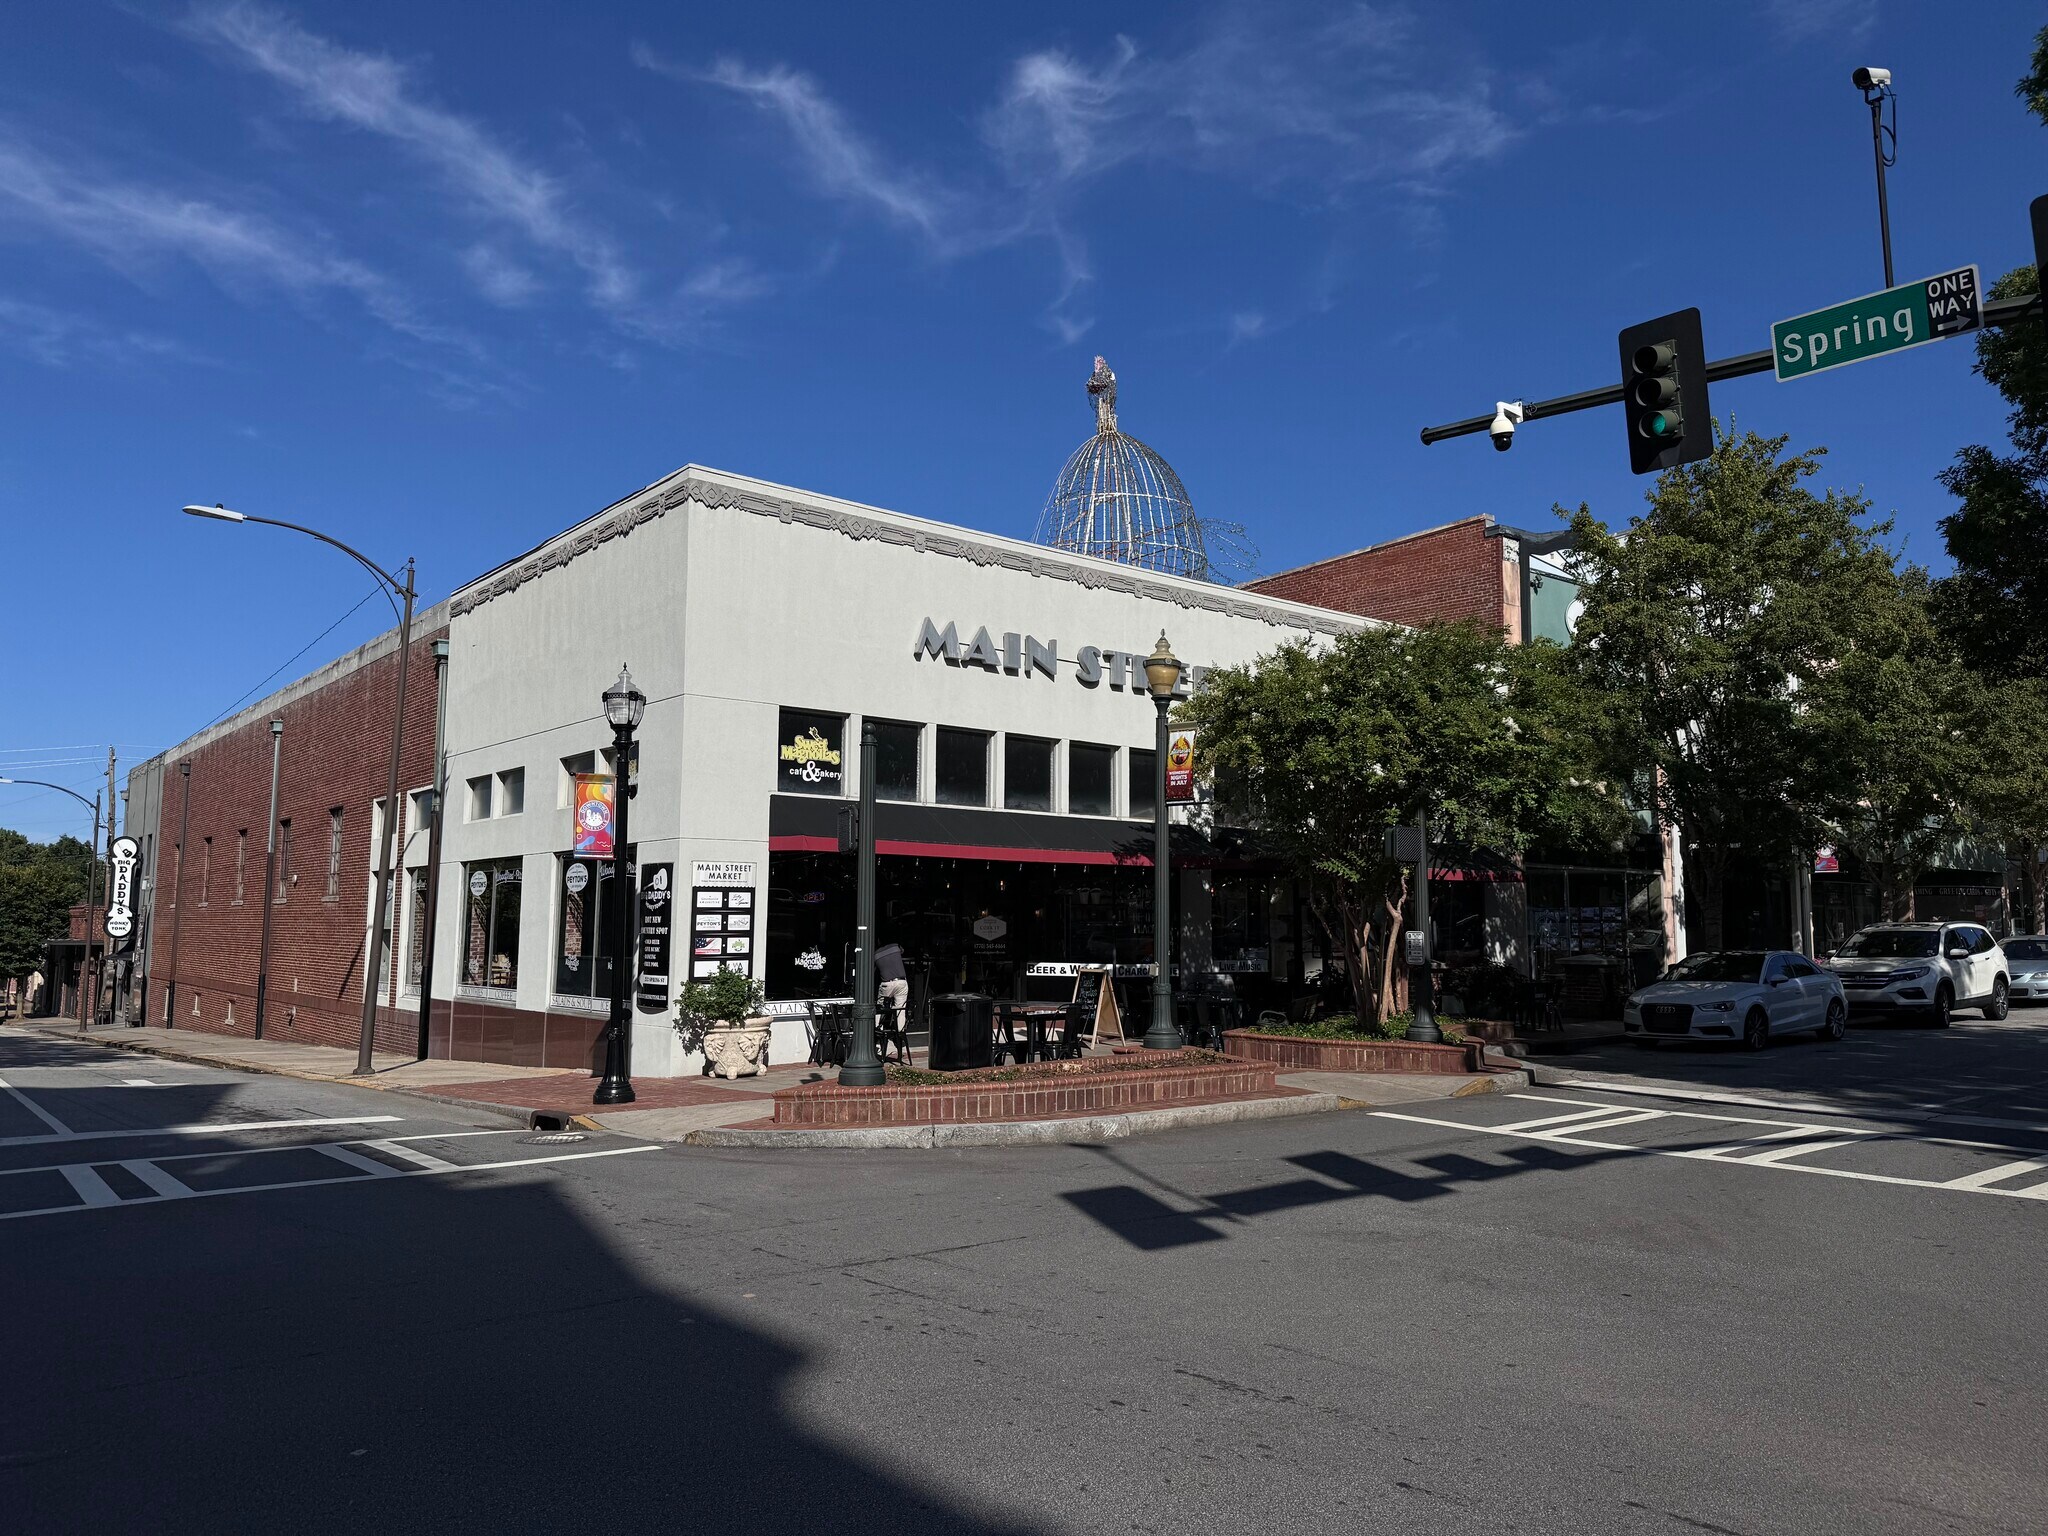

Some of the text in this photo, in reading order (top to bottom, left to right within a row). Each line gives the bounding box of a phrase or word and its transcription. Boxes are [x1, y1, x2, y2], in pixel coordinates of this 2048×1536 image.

[1928, 272, 1972, 298] ONE
[1929, 292, 1974, 318] WAY
[1783, 308, 1914, 367] Spring
[914, 616, 1057, 676] MAIN
[794, 735, 828, 752] Sweet
[780, 745, 840, 765] Magnolias
[802, 761, 821, 782] &
[708, 872, 742, 880] MARKET
[725, 864, 752, 872] STREET
[567, 875, 587, 883] PEYTON'S
[1027, 964, 1056, 975] BEER
[1219, 961, 1262, 971] LIVE MUSIC
